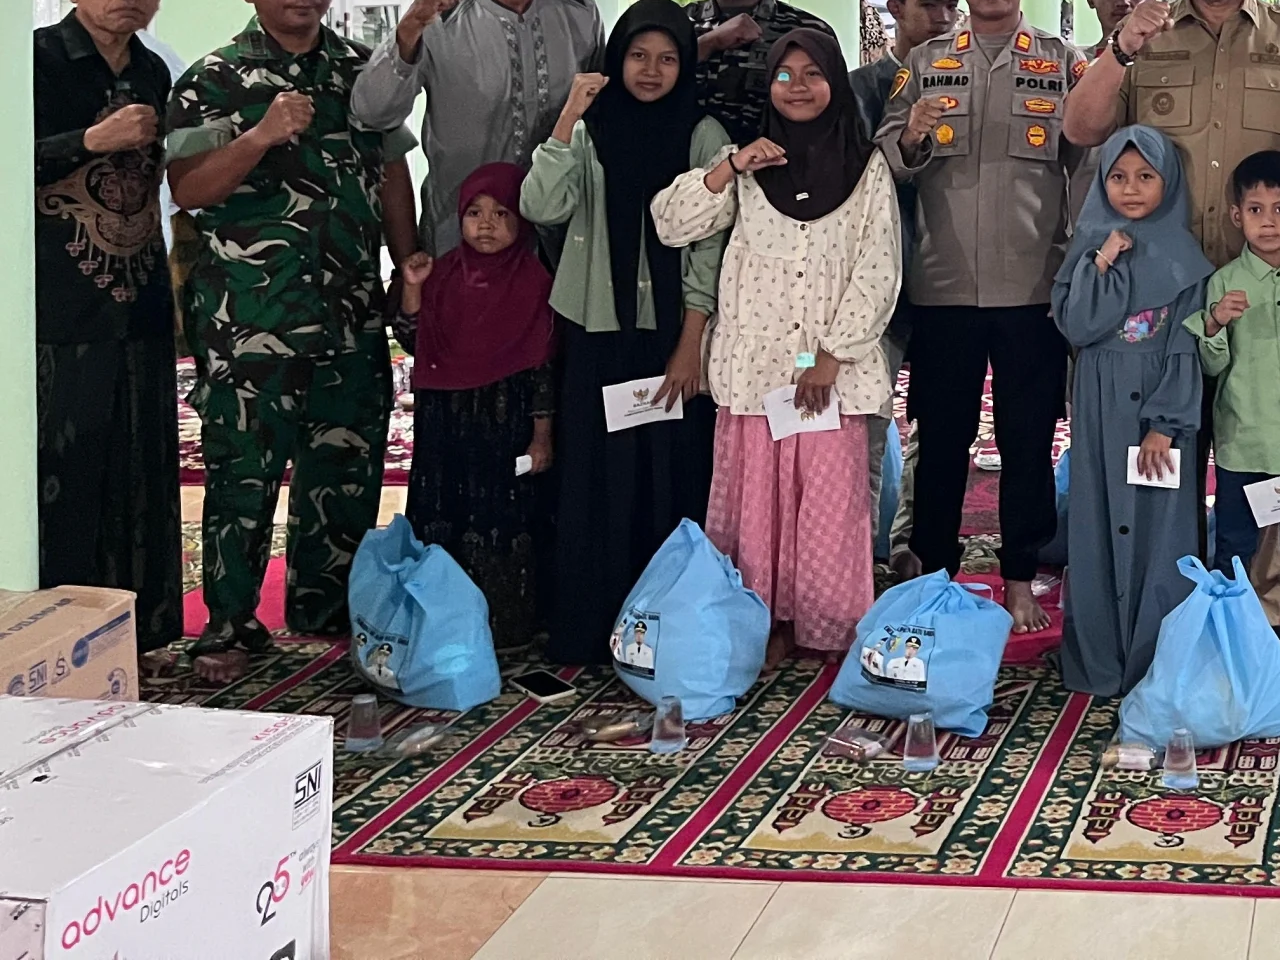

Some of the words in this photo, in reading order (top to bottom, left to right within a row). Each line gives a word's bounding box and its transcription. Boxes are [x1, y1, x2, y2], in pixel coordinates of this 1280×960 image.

[922, 75, 969, 89] RAHMAD
[1016, 77, 1063, 91] POLRI
[294, 763, 322, 805] SNI
[62, 848, 191, 949] advance
[140, 880, 189, 923] Digitals
